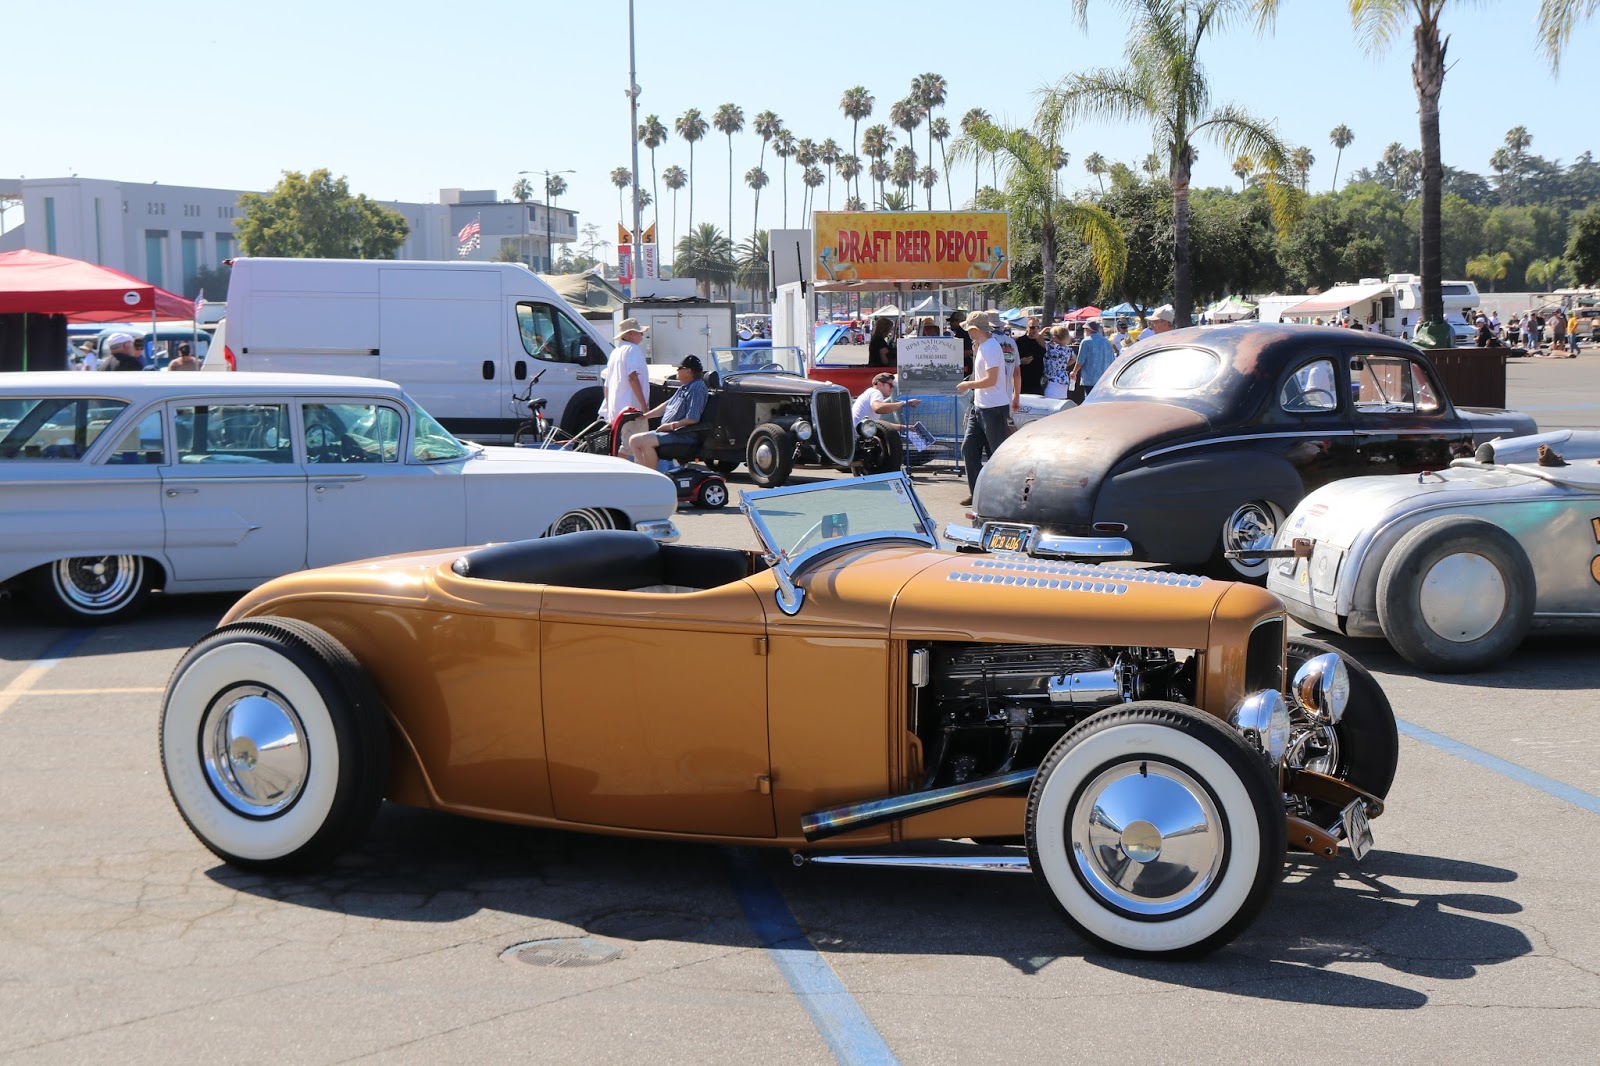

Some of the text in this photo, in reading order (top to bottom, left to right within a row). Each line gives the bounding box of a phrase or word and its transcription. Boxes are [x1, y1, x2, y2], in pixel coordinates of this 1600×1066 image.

[623, 235, 629, 243] 5
[646, 235, 652, 243] 5
[838, 230, 988, 263] DRAFT BEER DEPOT
[921, 339, 956, 351] NATIONALS
